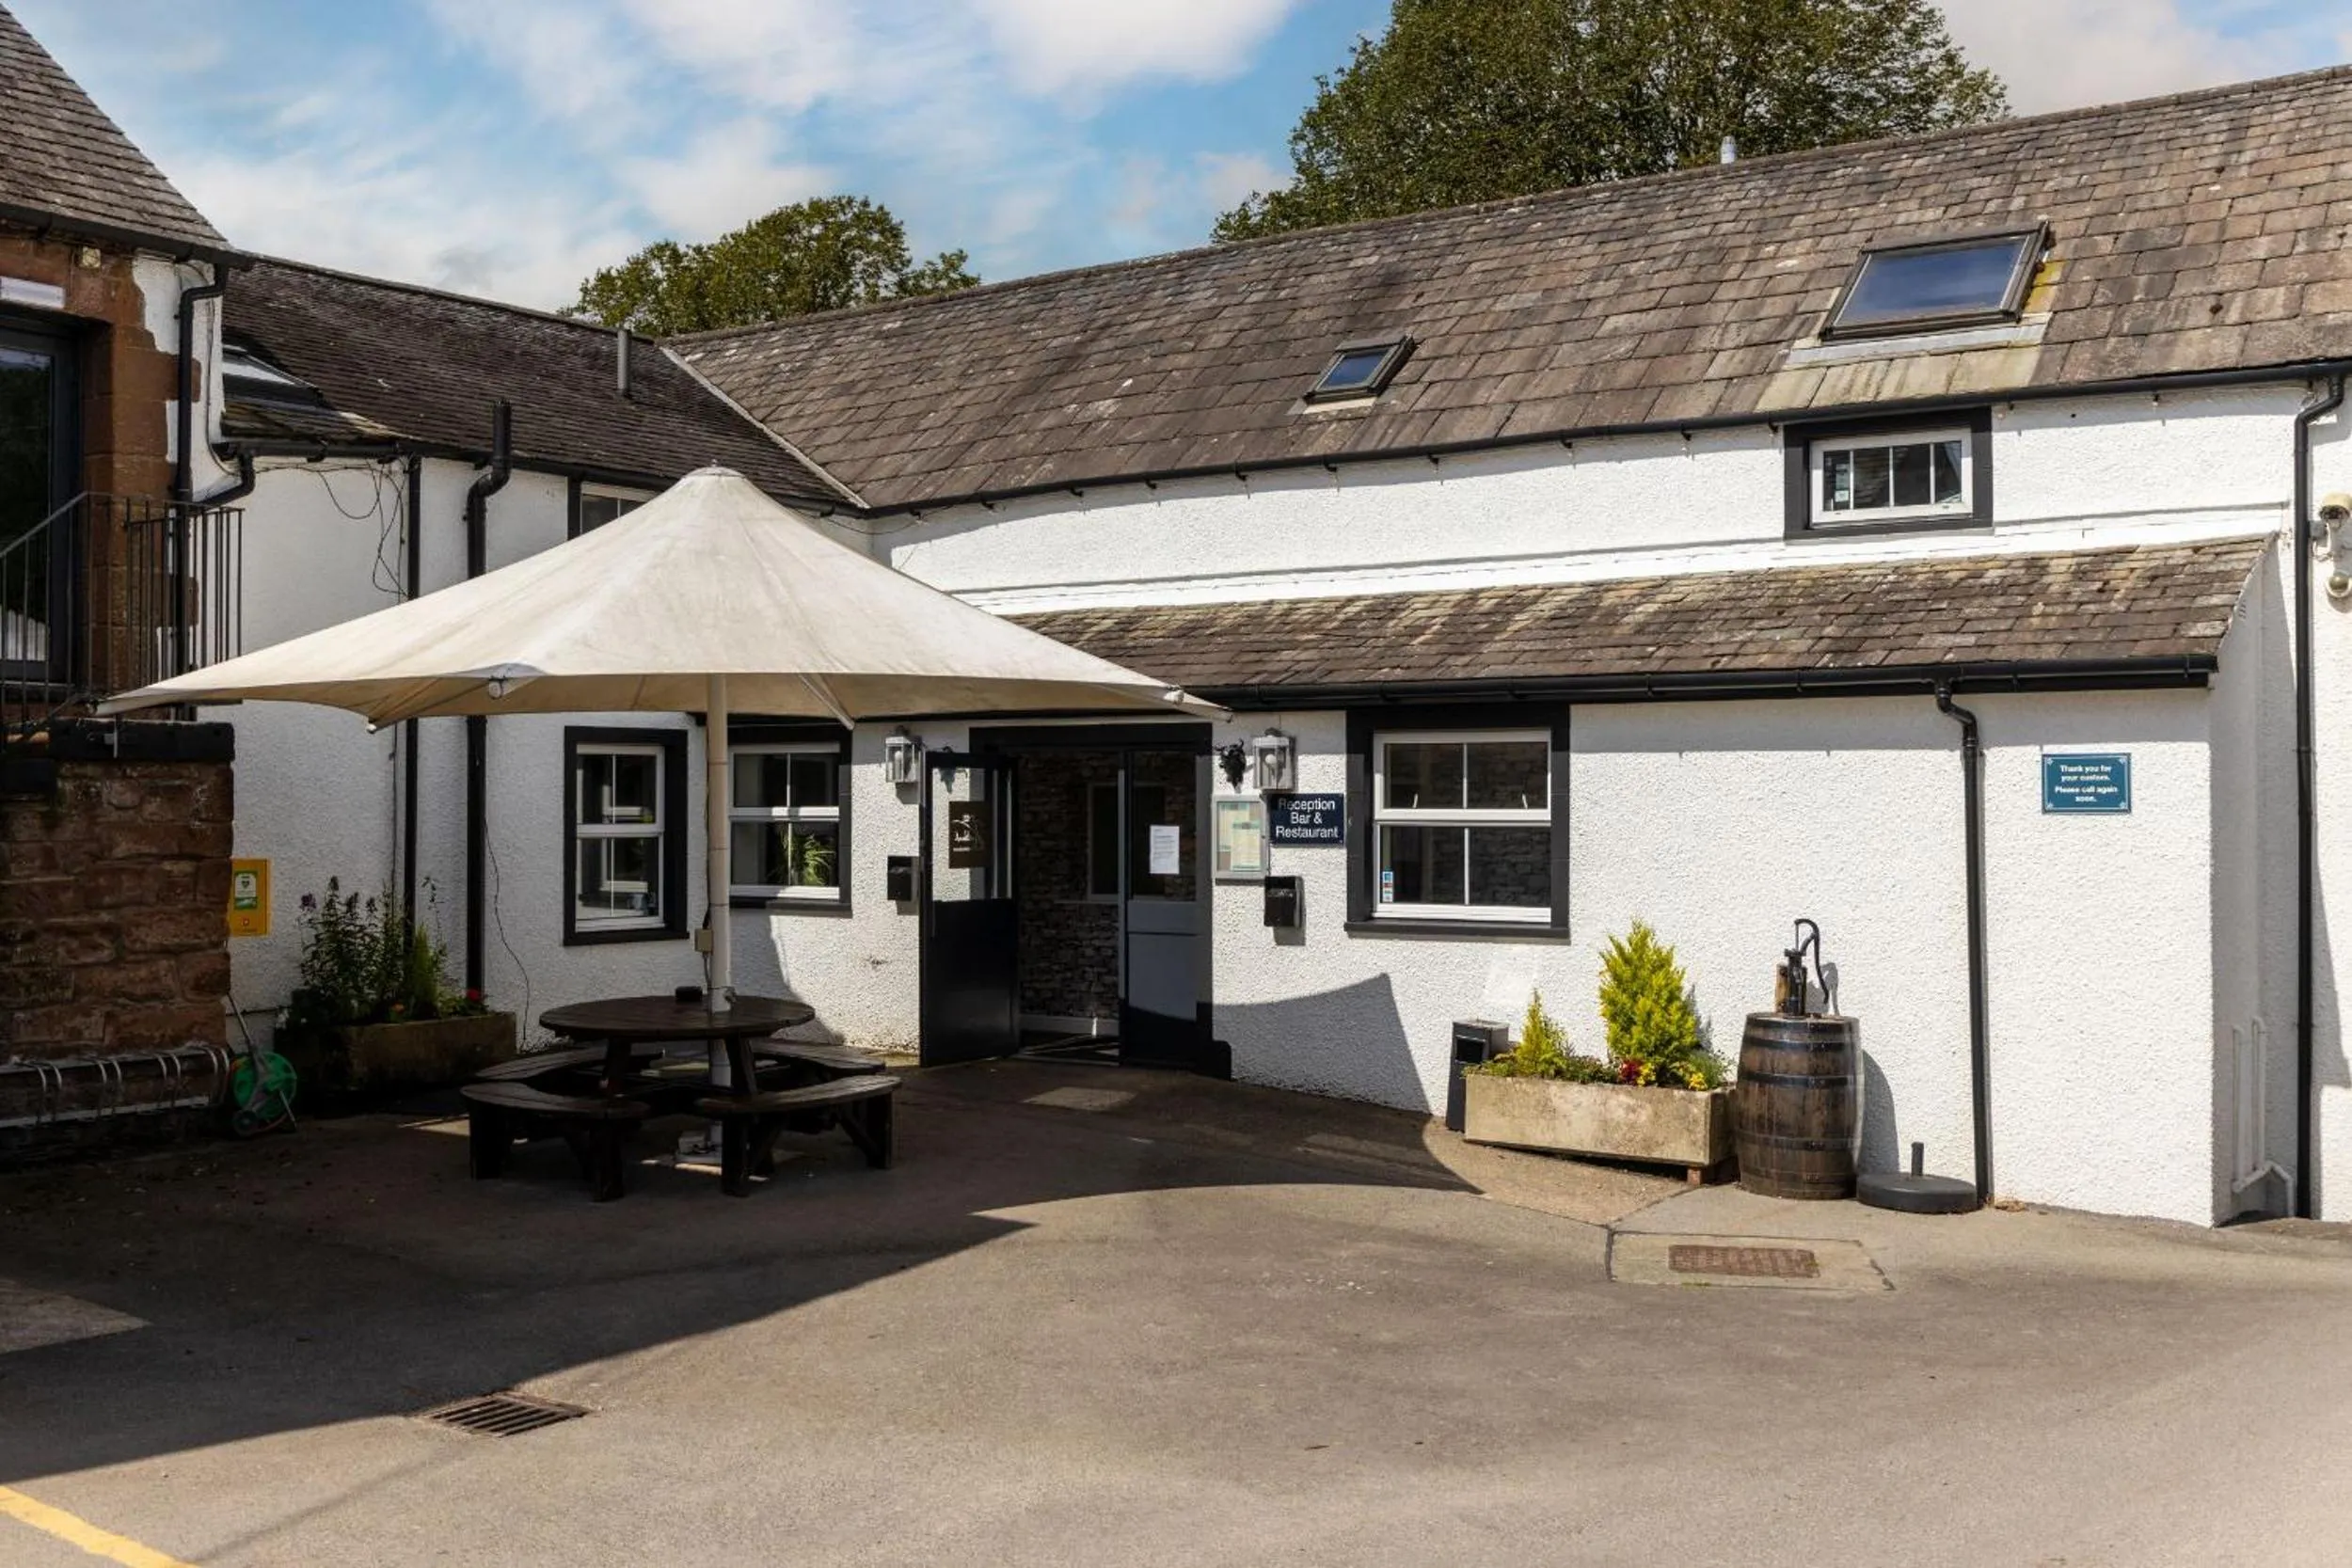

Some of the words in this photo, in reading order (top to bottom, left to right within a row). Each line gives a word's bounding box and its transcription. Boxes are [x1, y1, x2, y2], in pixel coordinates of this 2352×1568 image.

[1279, 798, 1335, 813] Reception
[1291, 812, 1311, 824] Bar
[1313, 812, 1323, 824] &
[1276, 825, 1339, 838] Restaurant
